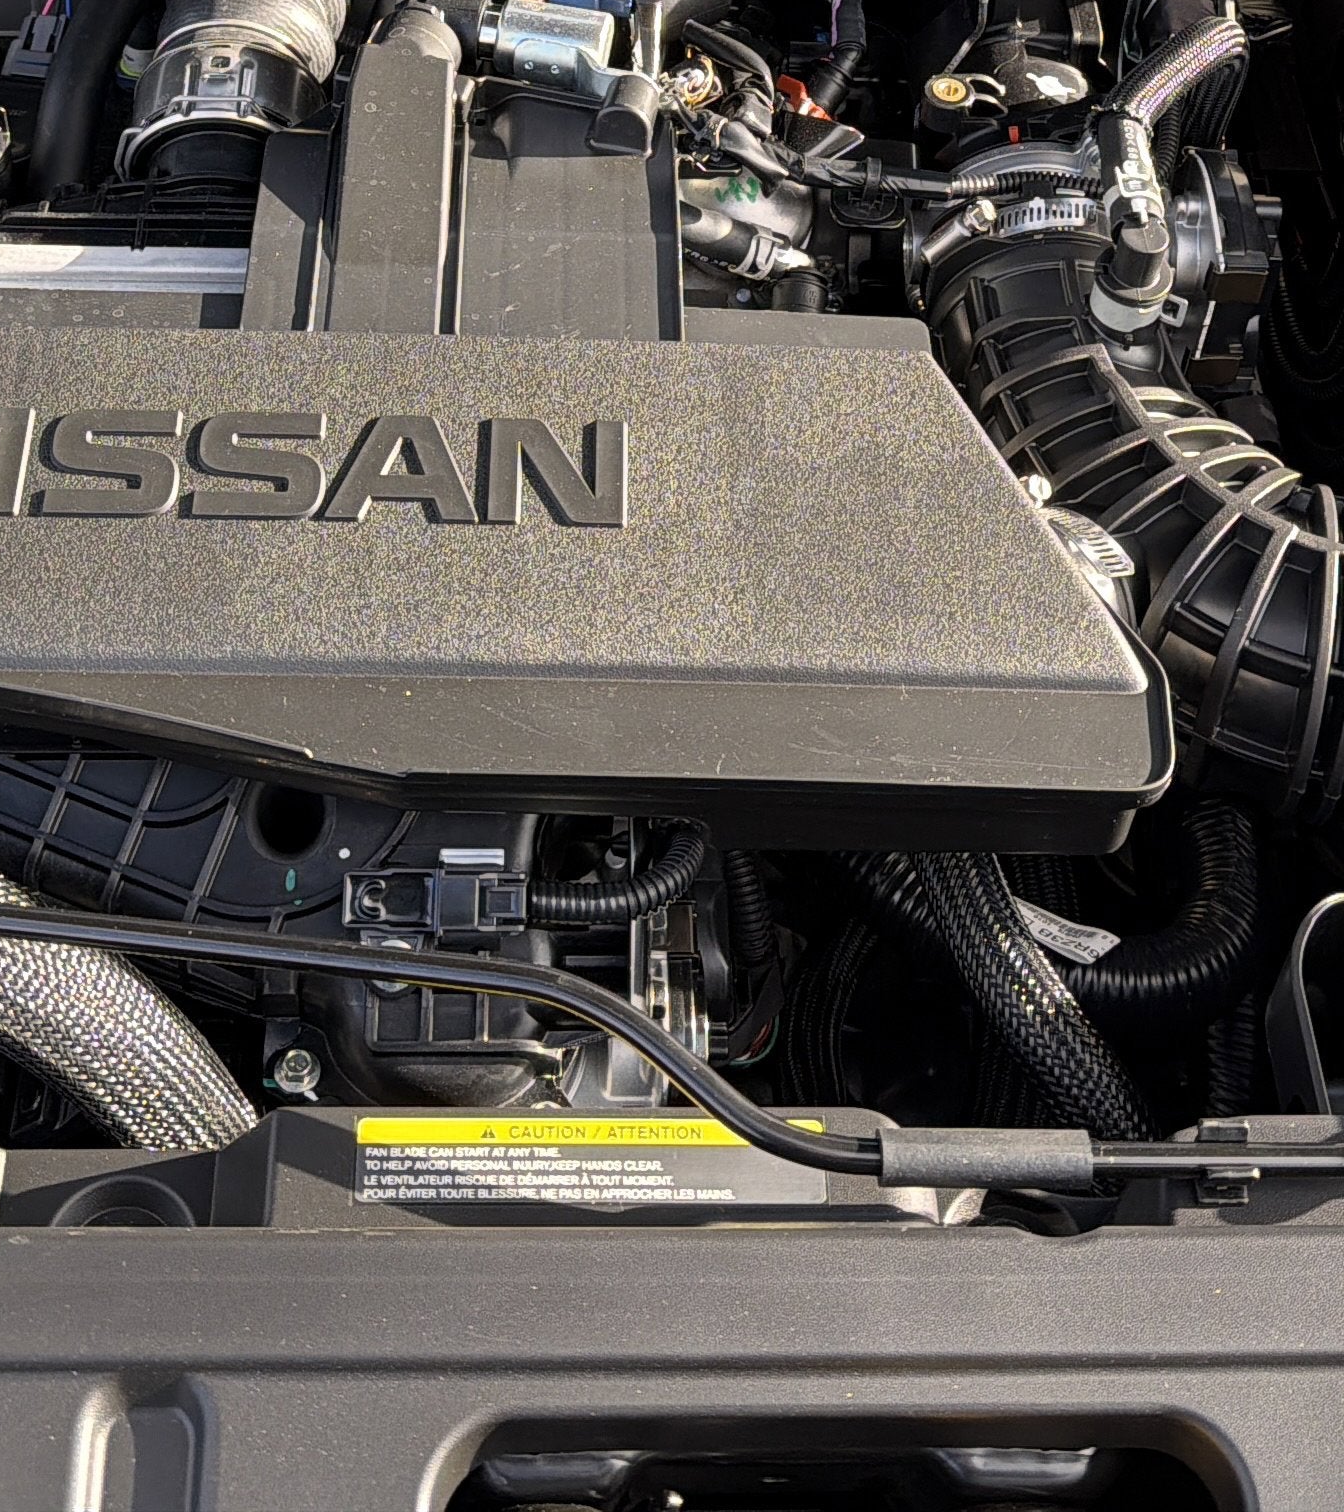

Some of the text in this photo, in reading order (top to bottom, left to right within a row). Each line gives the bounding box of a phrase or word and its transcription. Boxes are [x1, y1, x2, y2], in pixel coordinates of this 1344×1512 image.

[509, 1125, 587, 1140] CAUTION
[607, 1125, 702, 1140] ATTENTION
[365, 1147, 387, 1158] FAN
[389, 1147, 427, 1158] BLADE
[428, 1147, 453, 1158] CAN
[455, 1147, 490, 1158] START
[491, 1147, 506, 1158] AT
[508, 1147, 532, 1158] ANY
[365, 1160, 381, 1171] TO
[383, 1160, 412, 1171] HELP
[414, 1160, 448, 1171] AVOID
[450, 1160, 511, 1171] PERSONAL
[582, 1160, 622, 1171] HANDS
[364, 1175, 378, 1186] LE
[380, 1175, 452, 1186] VENTILATEUR
[454, 1175, 497, 1186] RISQUE
[498, 1175, 518, 1186] DE
[520, 1172, 580, 1186] DÉMARRER
[591, 1175, 621, 1186] TOUT
[363, 1188, 397, 1200] POUR
[398, 1185, 439, 1200] ÉVITER
[440, 1188, 475, 1200] TOUTE
[541, 1188, 558, 1200] NE
[559, 1188, 582, 1200] PAS
[584, 1188, 600, 1200] EN
[601, 1188, 673, 1200] APPROCHER
[673, 1188, 695, 1200] LES
